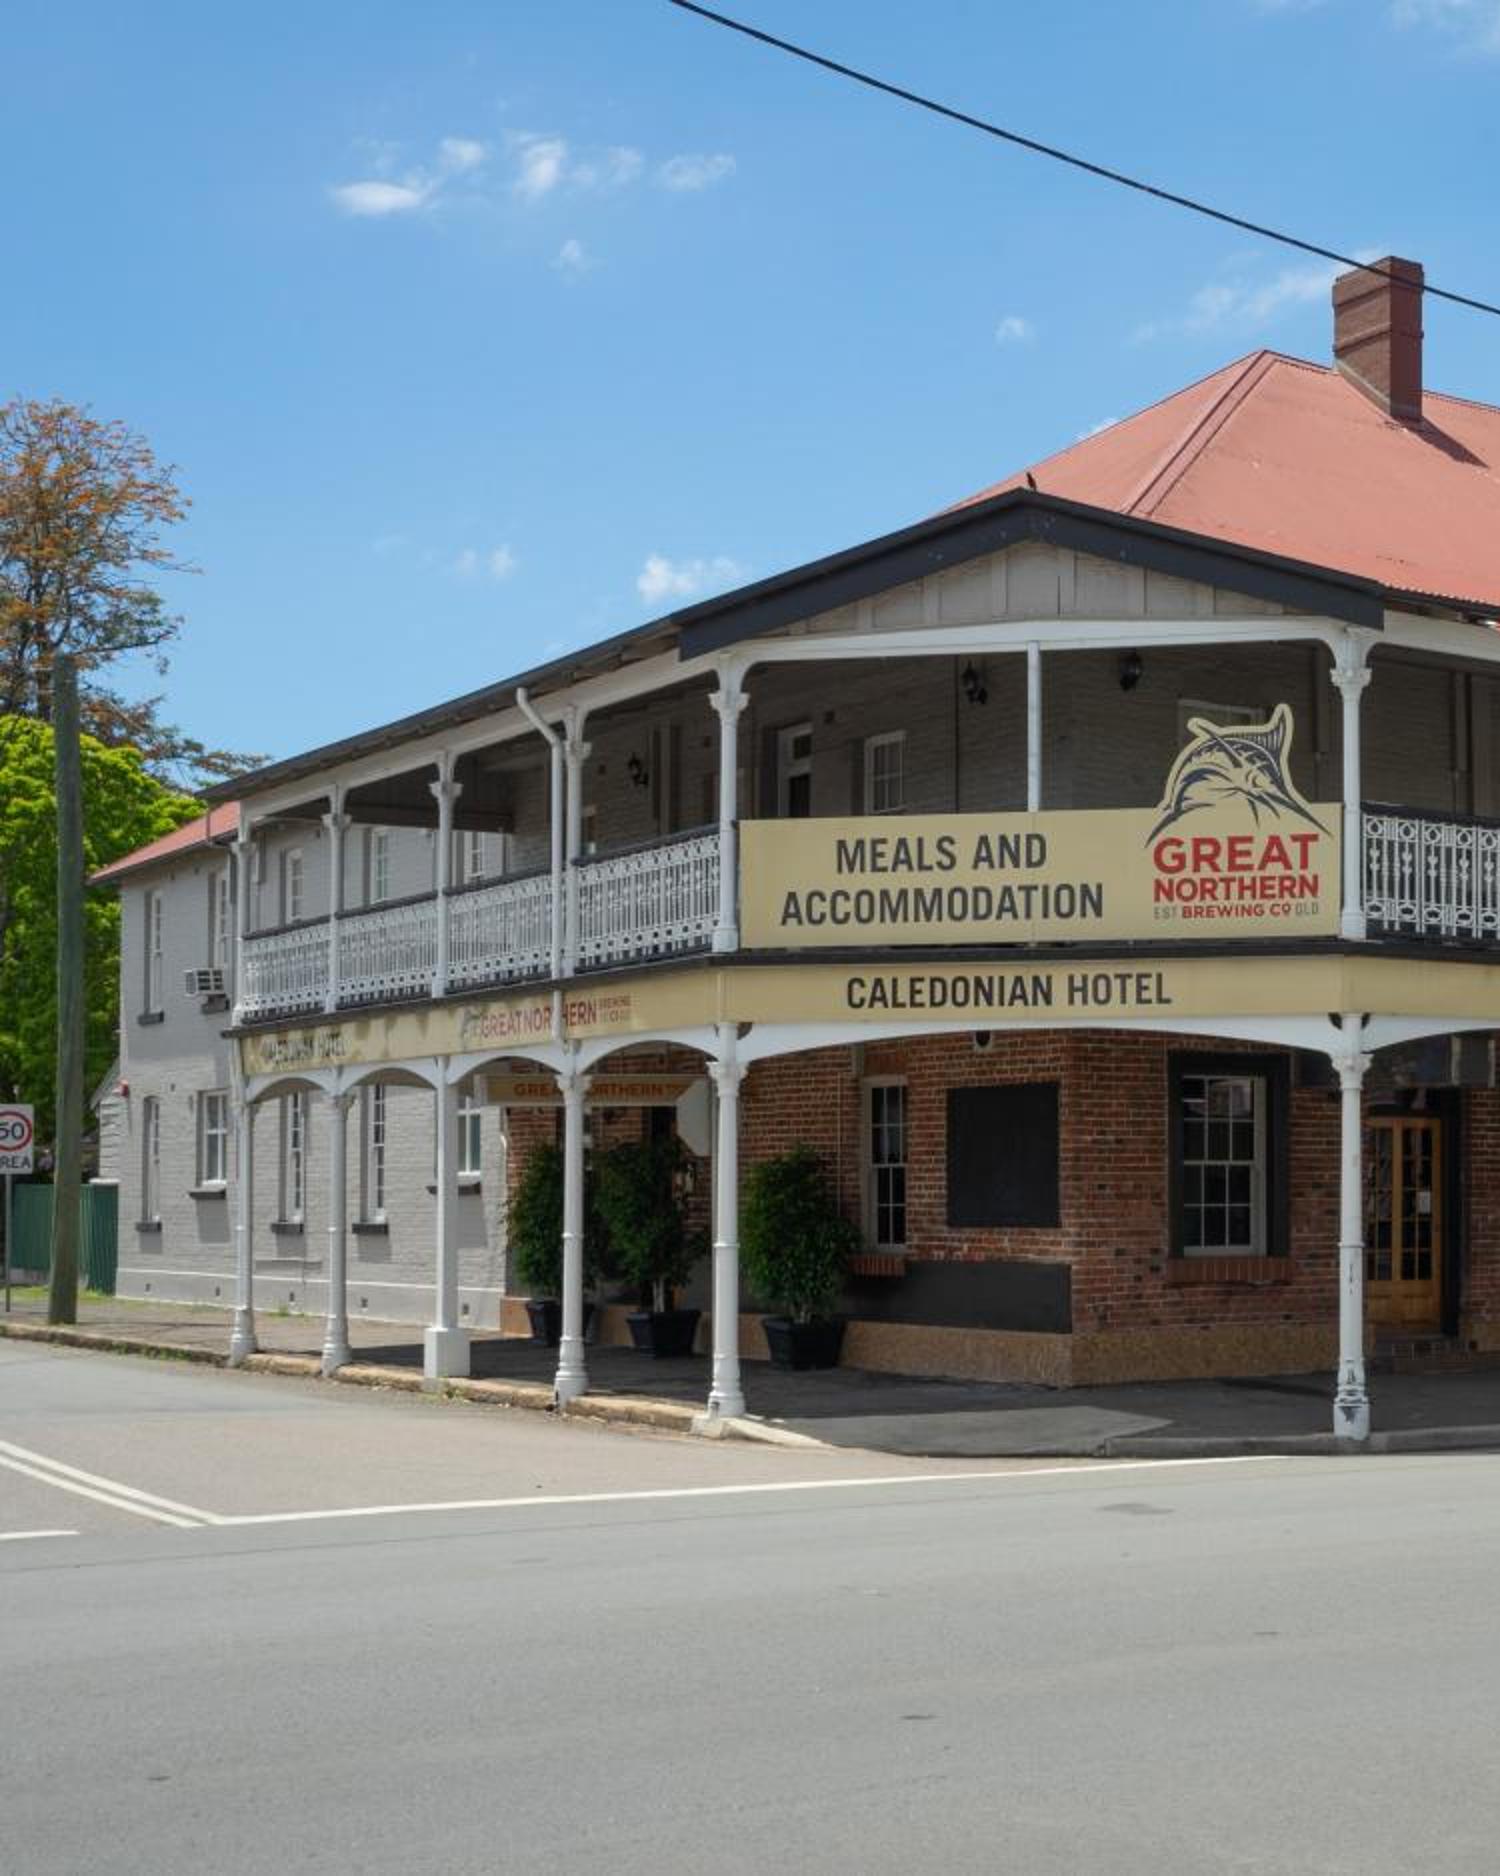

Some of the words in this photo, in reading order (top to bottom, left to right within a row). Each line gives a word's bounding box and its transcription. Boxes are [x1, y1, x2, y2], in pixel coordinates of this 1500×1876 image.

[836, 836, 957, 874] MEALS
[972, 833, 1047, 870] AND
[1153, 833, 1319, 874] GREAT
[780, 882, 1104, 926] ACCOMMODATION
[1153, 874, 1319, 902] NORTHERN
[1154, 906, 1177, 919] EST
[1181, 903, 1266, 919] BREWING
[847, 974, 1052, 1009] CALEDONIAN
[1067, 972, 1172, 1005] HOTEL
[481, 1009, 523, 1039] GREAT
[523, 999, 597, 1033] NORHERN
[0, 1120, 24, 1141] 50
[0, 1155, 31, 1169] REA
